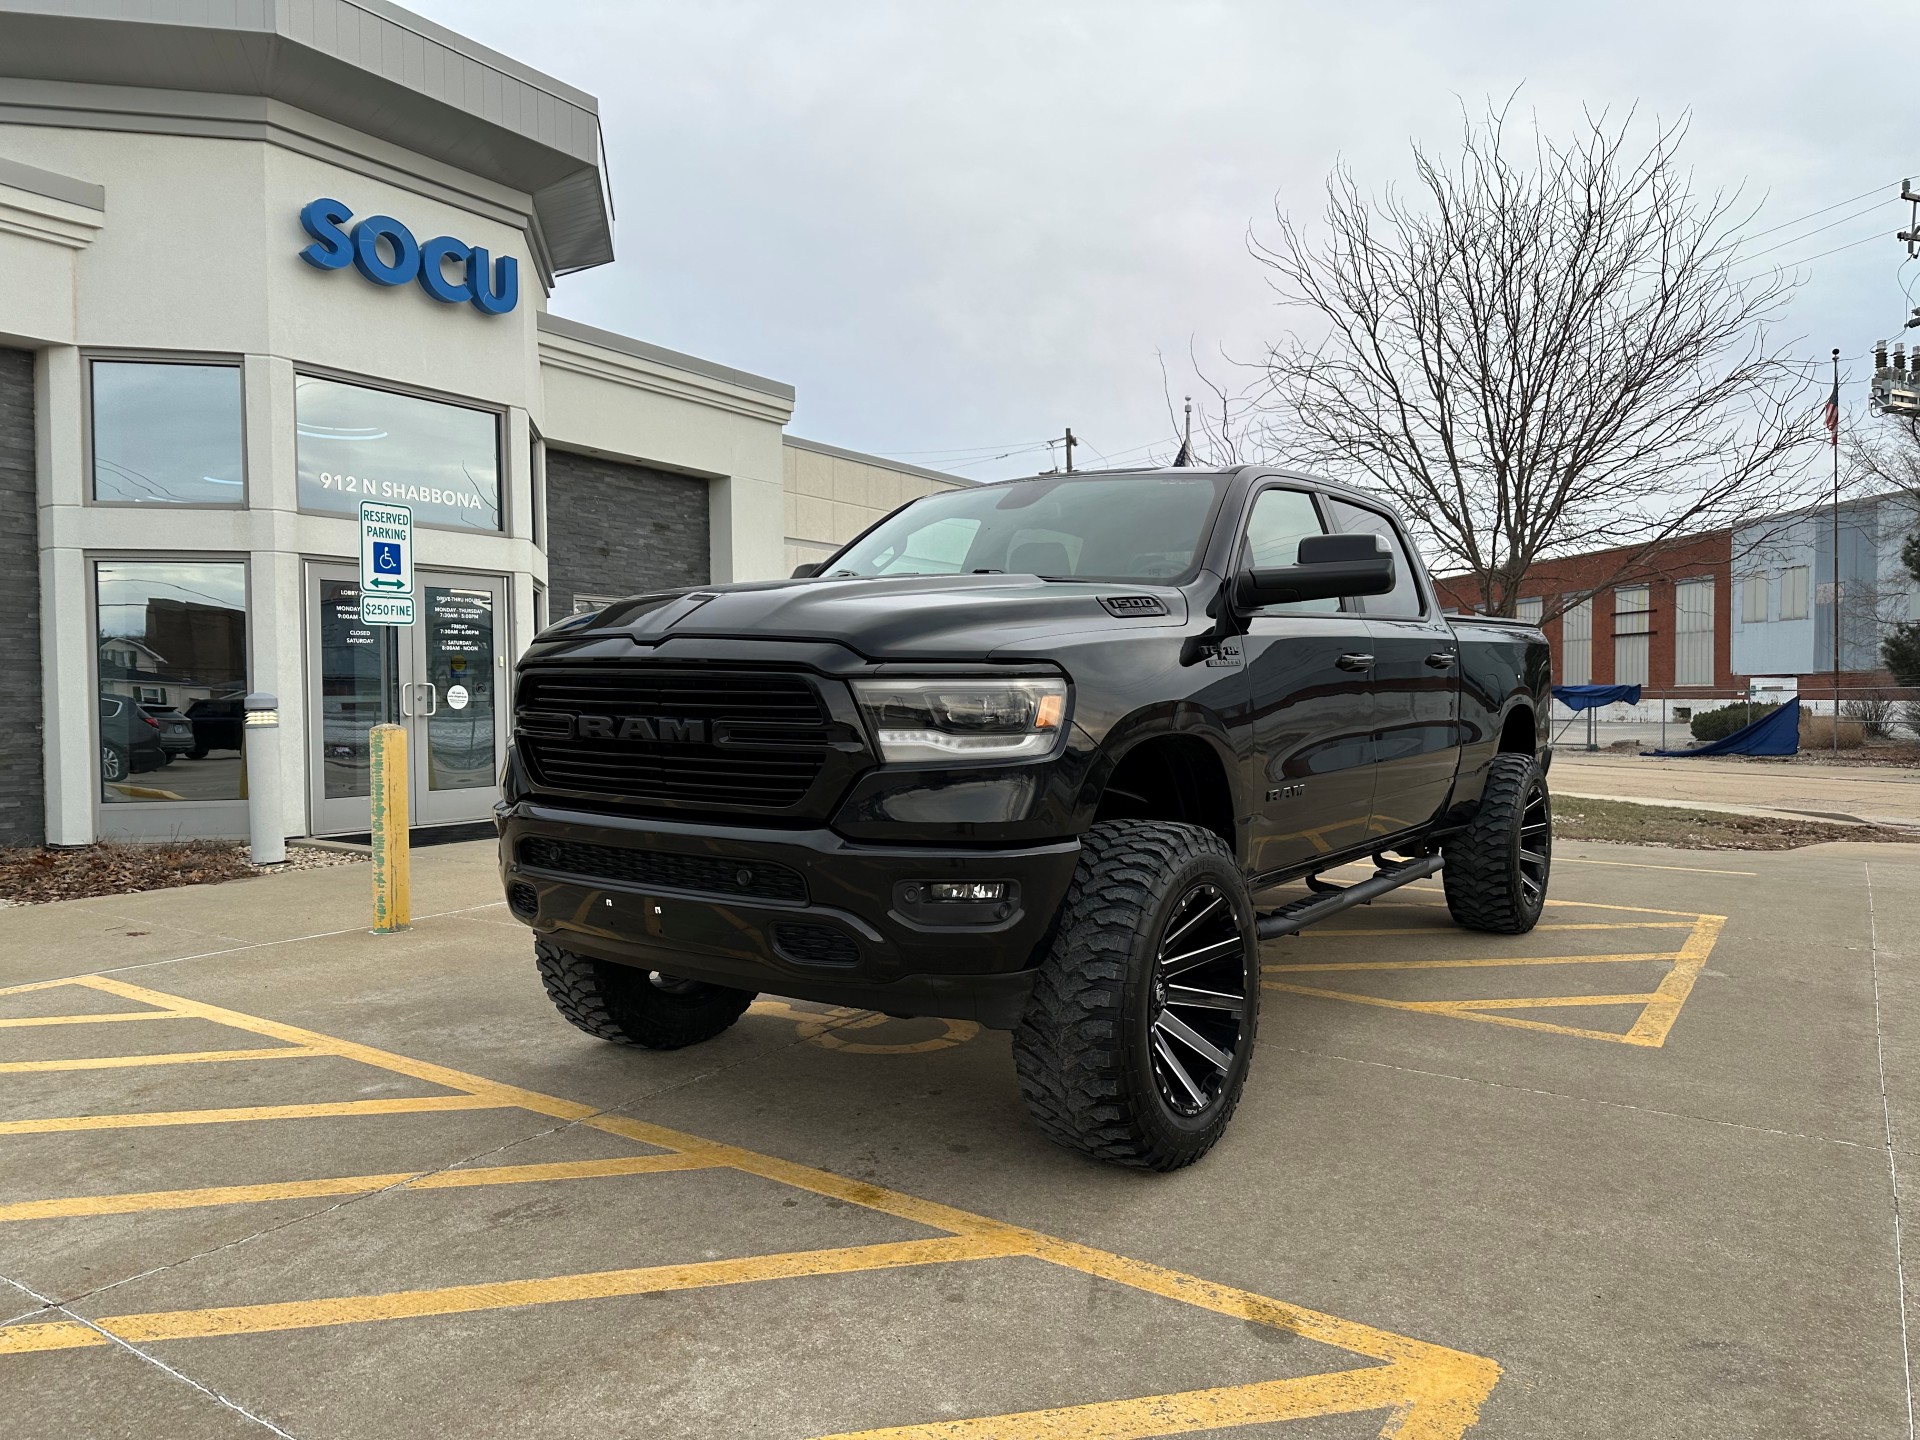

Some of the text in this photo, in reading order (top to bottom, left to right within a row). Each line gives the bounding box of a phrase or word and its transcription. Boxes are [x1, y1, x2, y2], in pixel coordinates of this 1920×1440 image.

[299, 198, 518, 315] SOCU
[320, 472, 482, 510] 912 N SHABBONA
[363, 509, 409, 526] RESERVED
[367, 525, 407, 541] PARKING
[365, 603, 411, 617] $250 FINE
[1110, 598, 1155, 608] 1500
[578, 714, 705, 743] RAM
[1265, 784, 1305, 802] RAM
